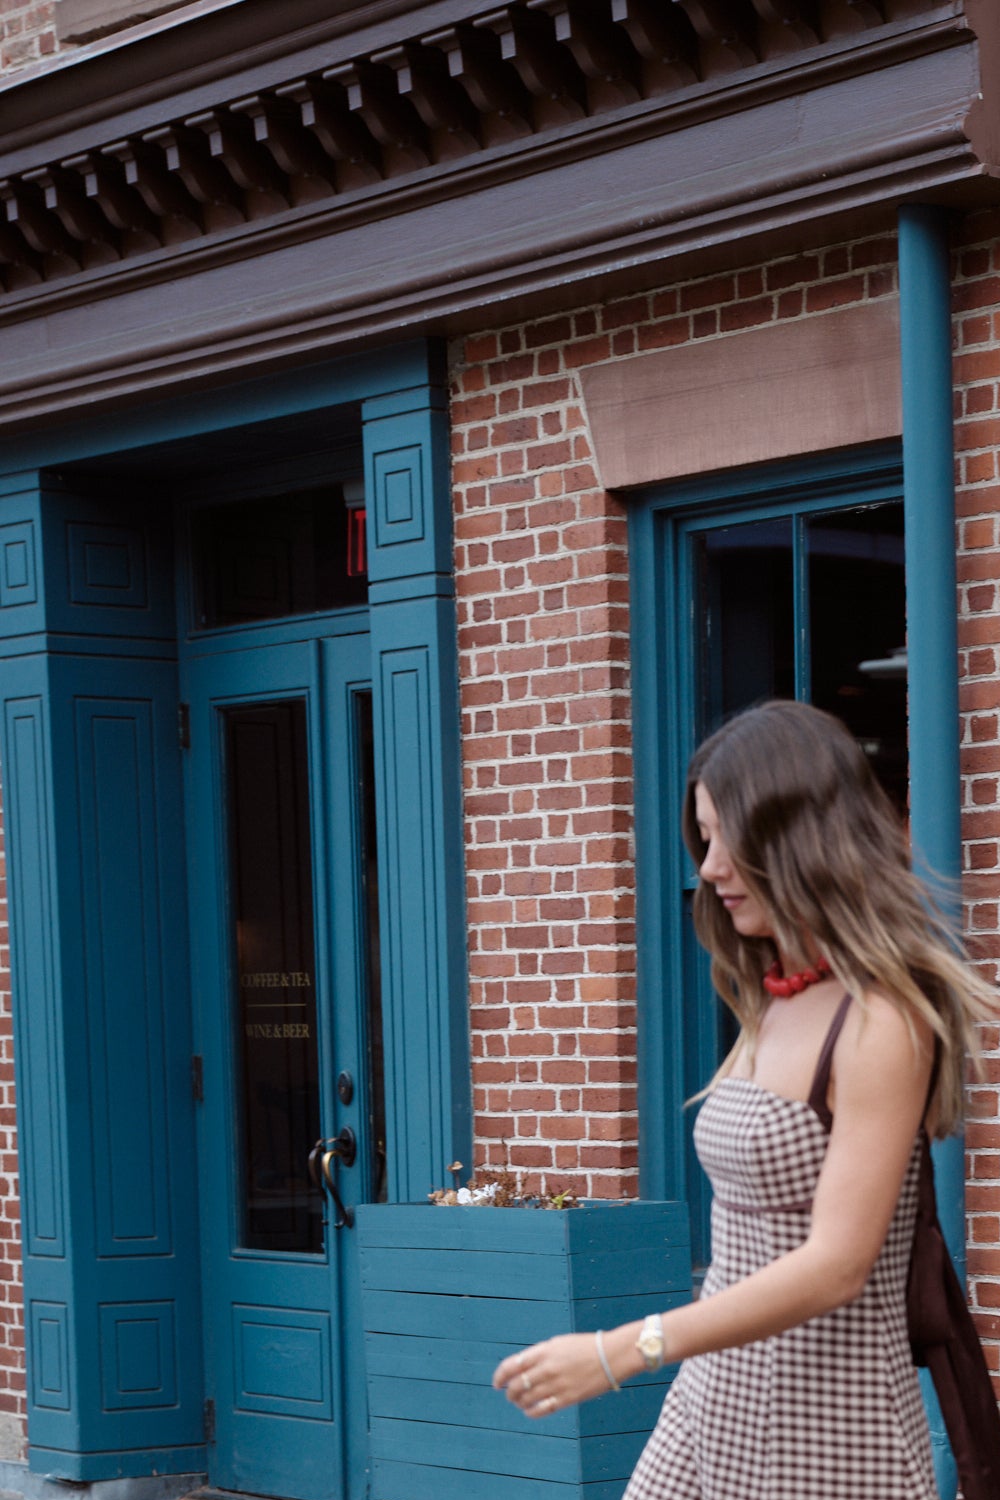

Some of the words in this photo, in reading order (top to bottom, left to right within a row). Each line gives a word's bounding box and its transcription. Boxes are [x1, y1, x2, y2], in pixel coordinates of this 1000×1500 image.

[241, 972, 280, 988] COFFEE
[290, 972, 311, 987] TEA
[245, 1023, 273, 1038] WINE
[283, 1023, 310, 1038] BEER
